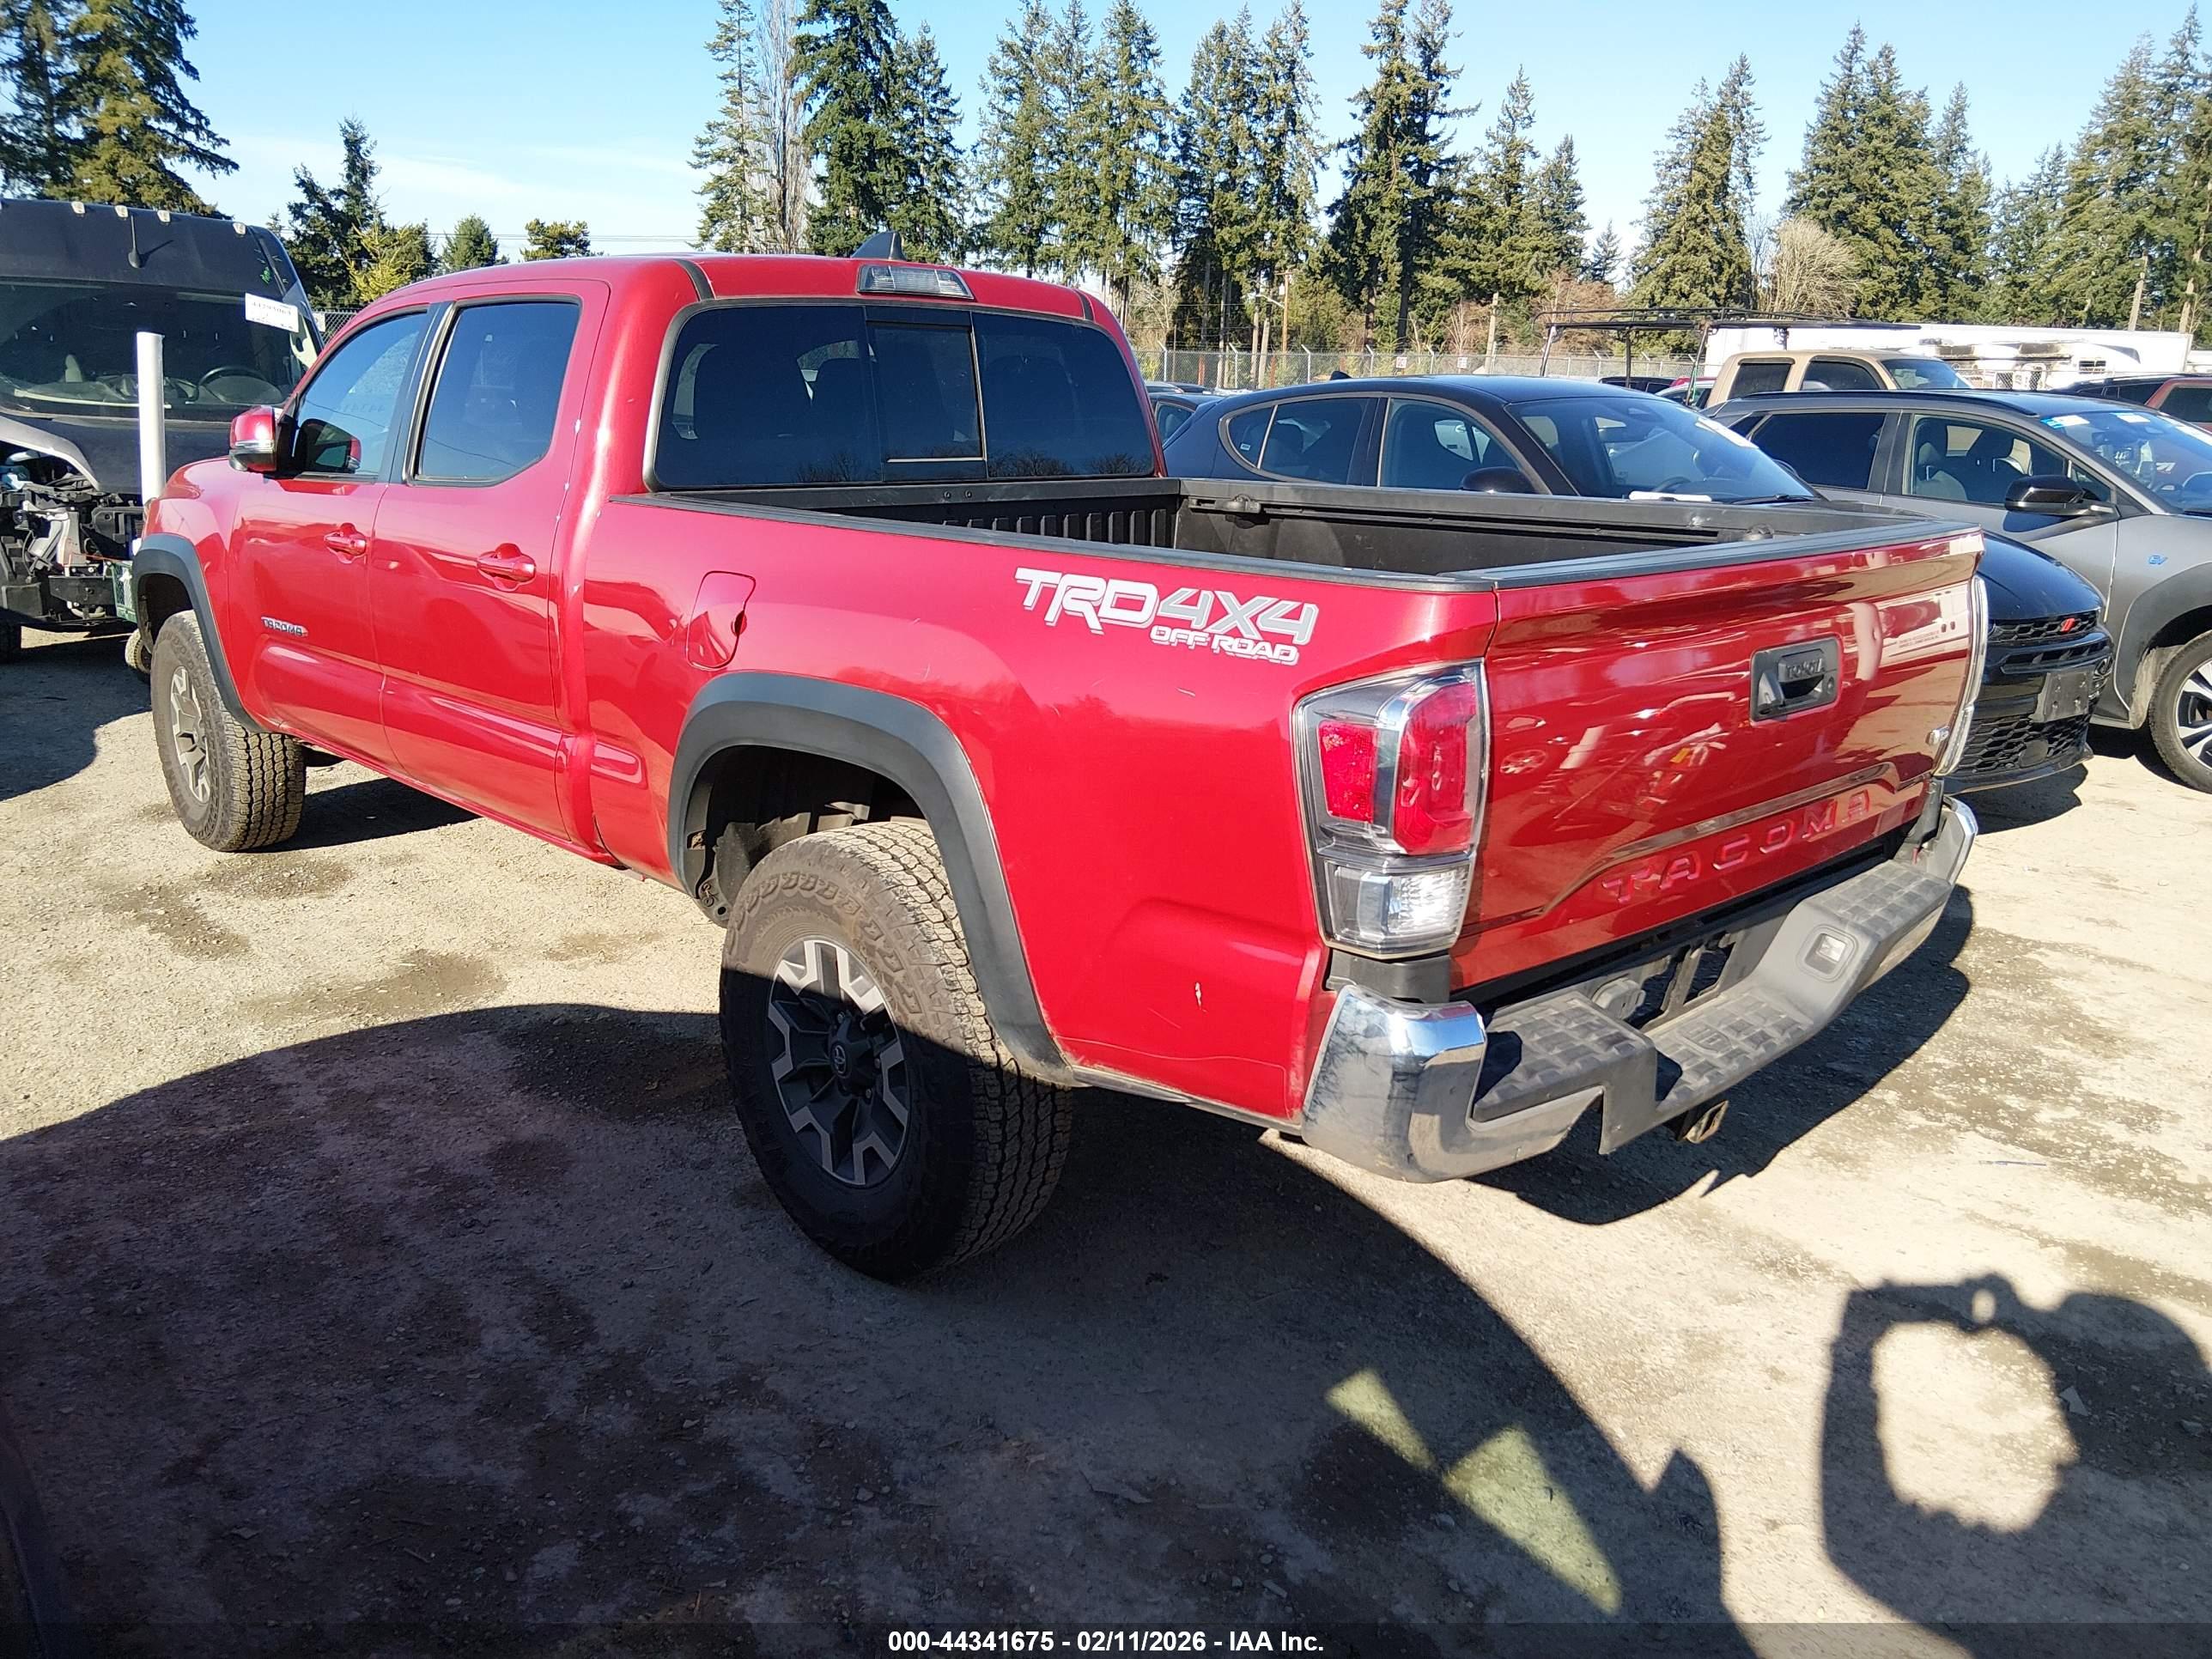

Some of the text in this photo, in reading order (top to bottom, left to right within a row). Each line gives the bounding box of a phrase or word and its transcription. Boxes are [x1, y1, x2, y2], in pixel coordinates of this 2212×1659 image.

[1015, 567, 1159, 636] TRD
[1150, 624, 1300, 666] OFF ROAD
[1601, 787, 1871, 903] TACOMA
